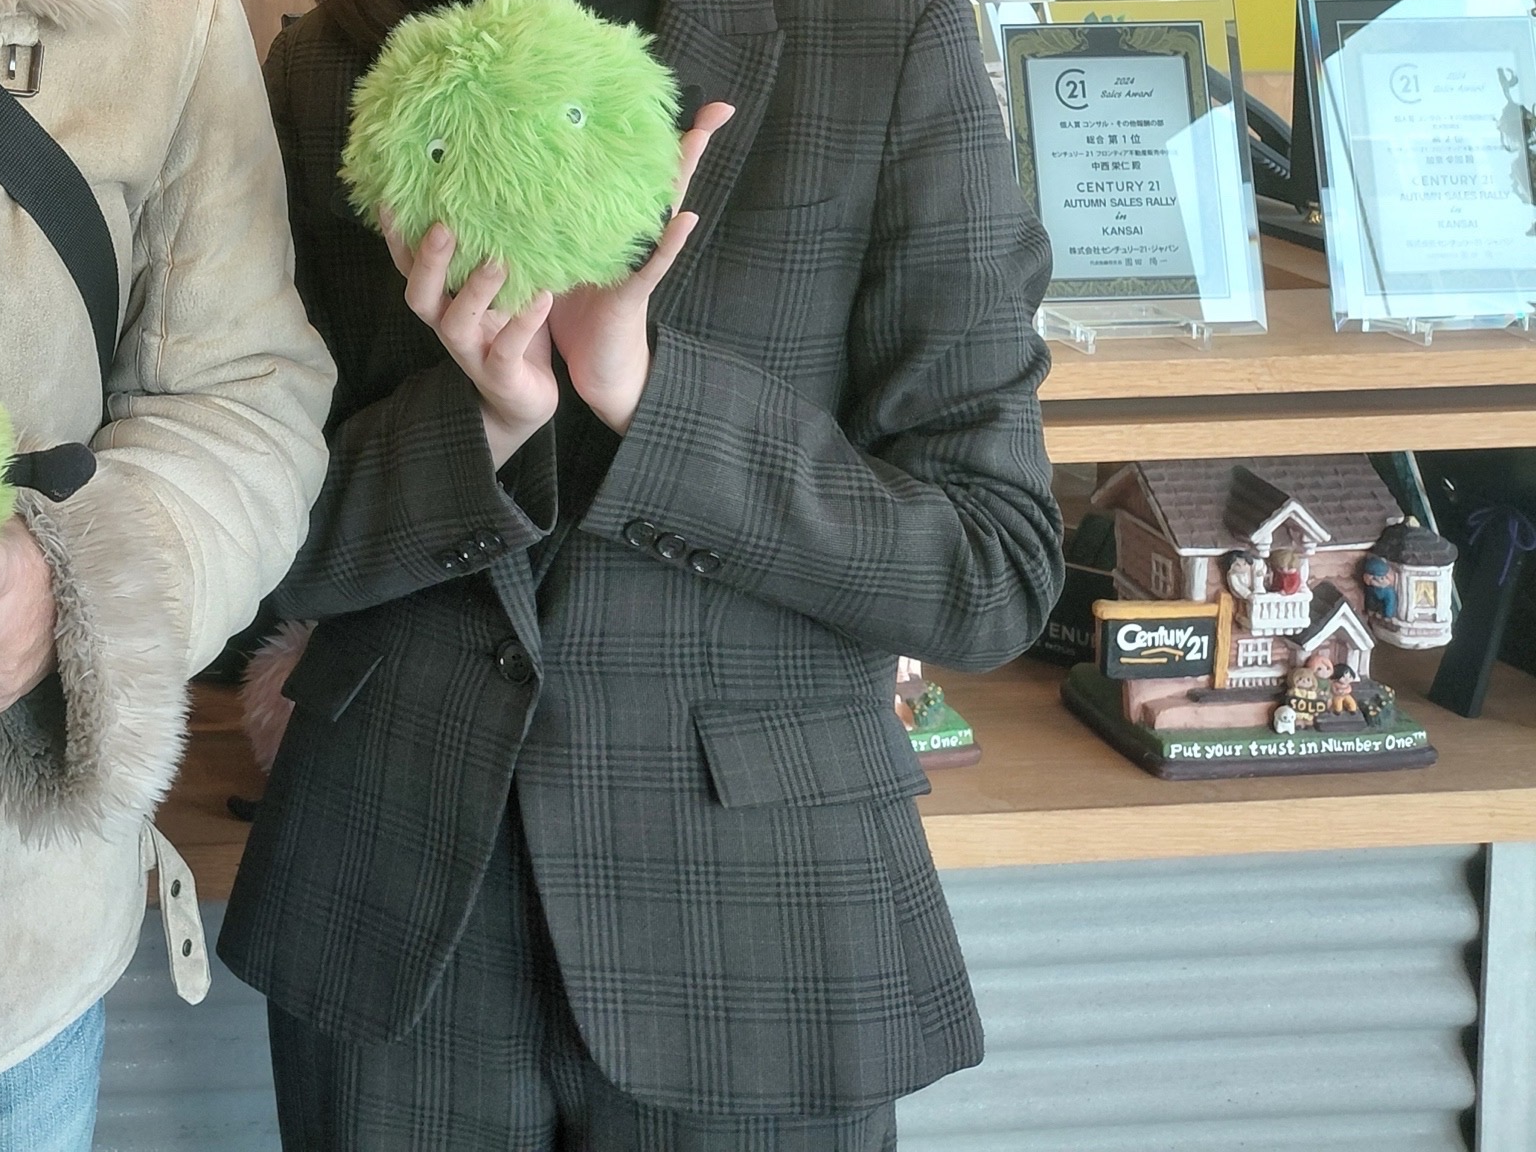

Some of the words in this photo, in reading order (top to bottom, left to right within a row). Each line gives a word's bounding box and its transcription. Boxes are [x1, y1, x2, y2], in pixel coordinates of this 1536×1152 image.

[1077, 181, 1144, 192] CENTURY
[1148, 180, 1161, 191] 21
[1064, 198, 1106, 208] AUTUMN
[1110, 198, 1143, 207] SALES
[1146, 196, 1177, 206] RALLY
[1102, 226, 1143, 236] KANSAI
[1117, 624, 1193, 650] Century
[1185, 635, 1208, 660] 21
[1290, 698, 1326, 713] SOLD
[1169, 743, 1201, 759] Put
[1204, 742, 1242, 759] your
[1249, 740, 1295, 756] trust
[1299, 740, 1316, 756] in
[1320, 737, 1382, 753] Number
